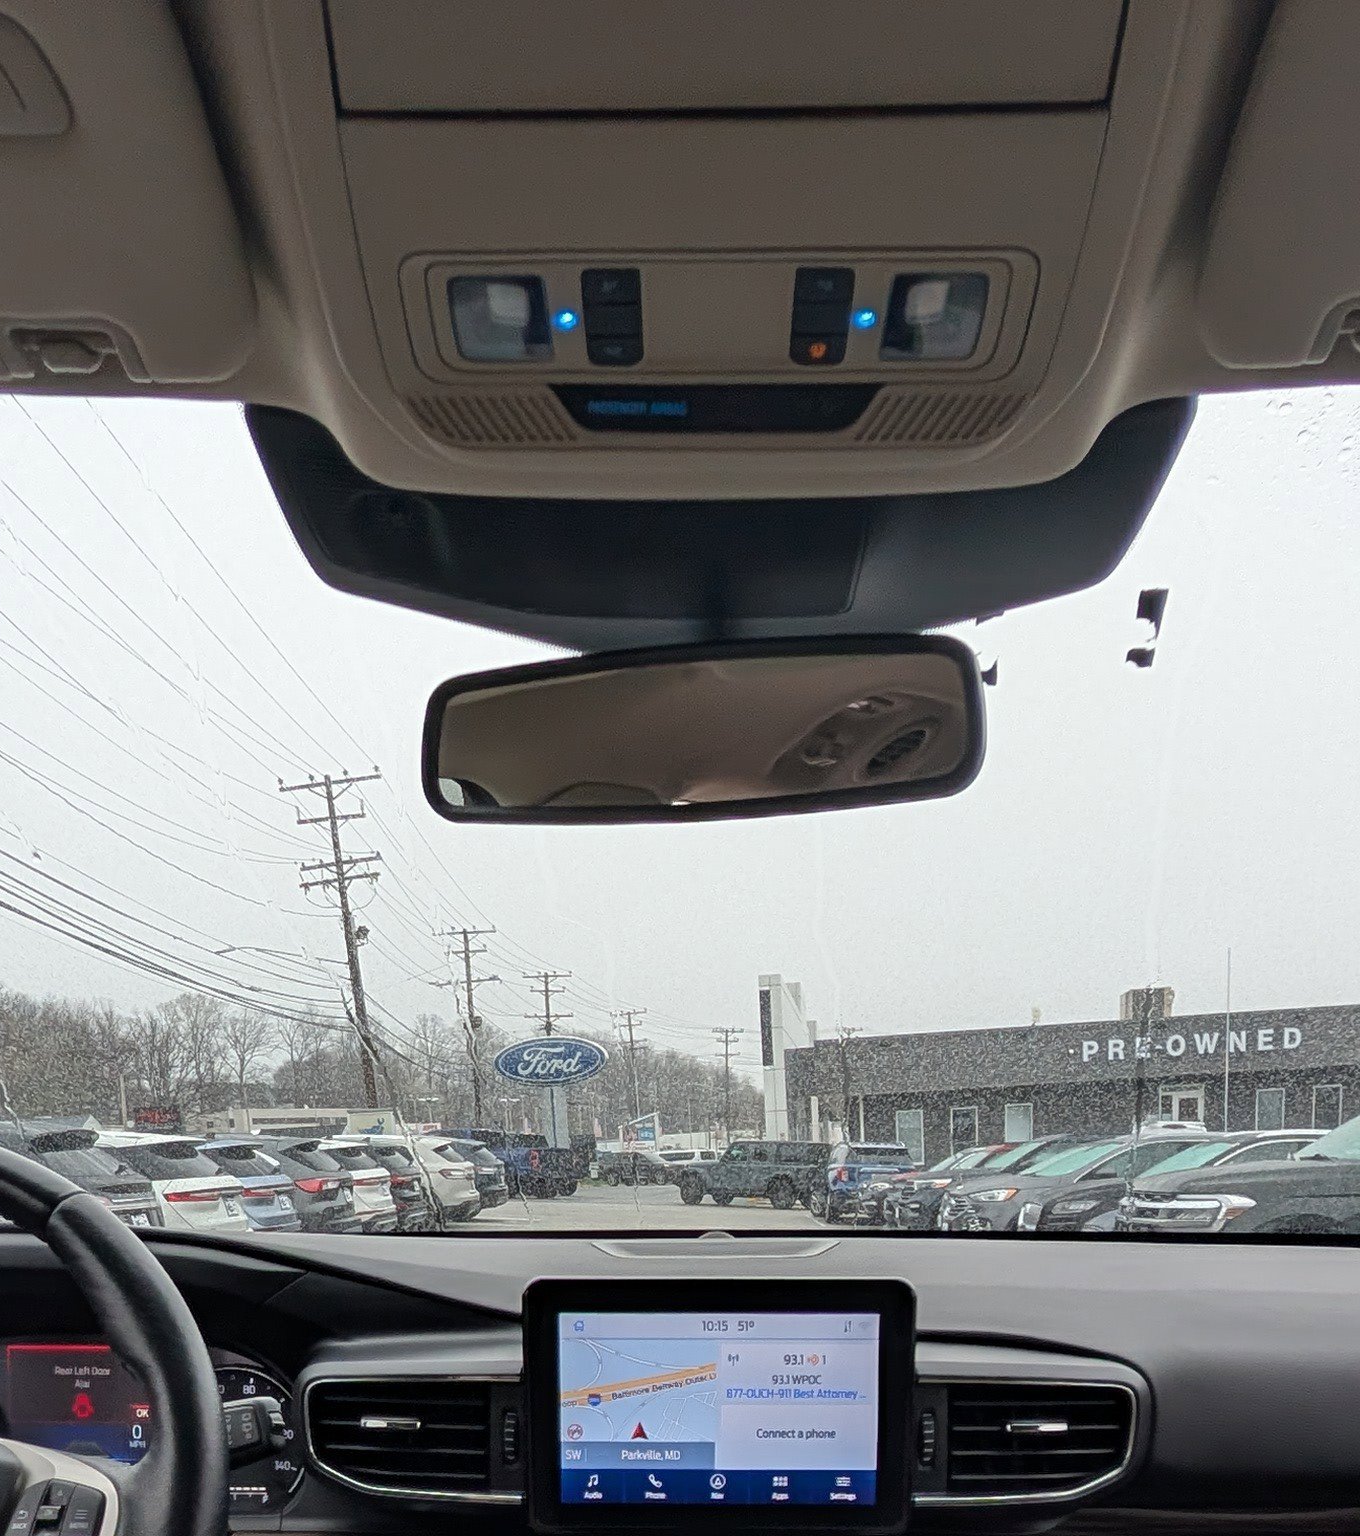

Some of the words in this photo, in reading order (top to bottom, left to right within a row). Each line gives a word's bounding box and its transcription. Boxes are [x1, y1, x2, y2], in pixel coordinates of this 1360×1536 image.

[1081, 1026, 1302, 1063] PRE-OWNED
[517, 1045, 582, 1076] Ford
[701, 1320, 729, 1332] 10:15
[783, 1354, 805, 1366] 93.1
[74, 1366, 90, 1376] Left
[91, 1366, 111, 1376] Door
[771, 1374, 790, 1385] 93.1
[791, 1374, 823, 1385] WPOC
[242, 1384, 256, 1395] 80
[611, 1387, 650, 1401] Baltimore
[793, 1388, 815, 1399] Best
[816, 1388, 859, 1400] Attorney
[136, 1408, 149, 1418] OK
[132, 1424, 142, 1440] 0
[756, 1428, 796, 1439] Connect
[797, 1431, 804, 1439] a
[805, 1428, 837, 1440] phone
[565, 1450, 582, 1461] SW
[621, 1450, 664, 1462] Parkville,
[665, 1450, 681, 1461] MD
